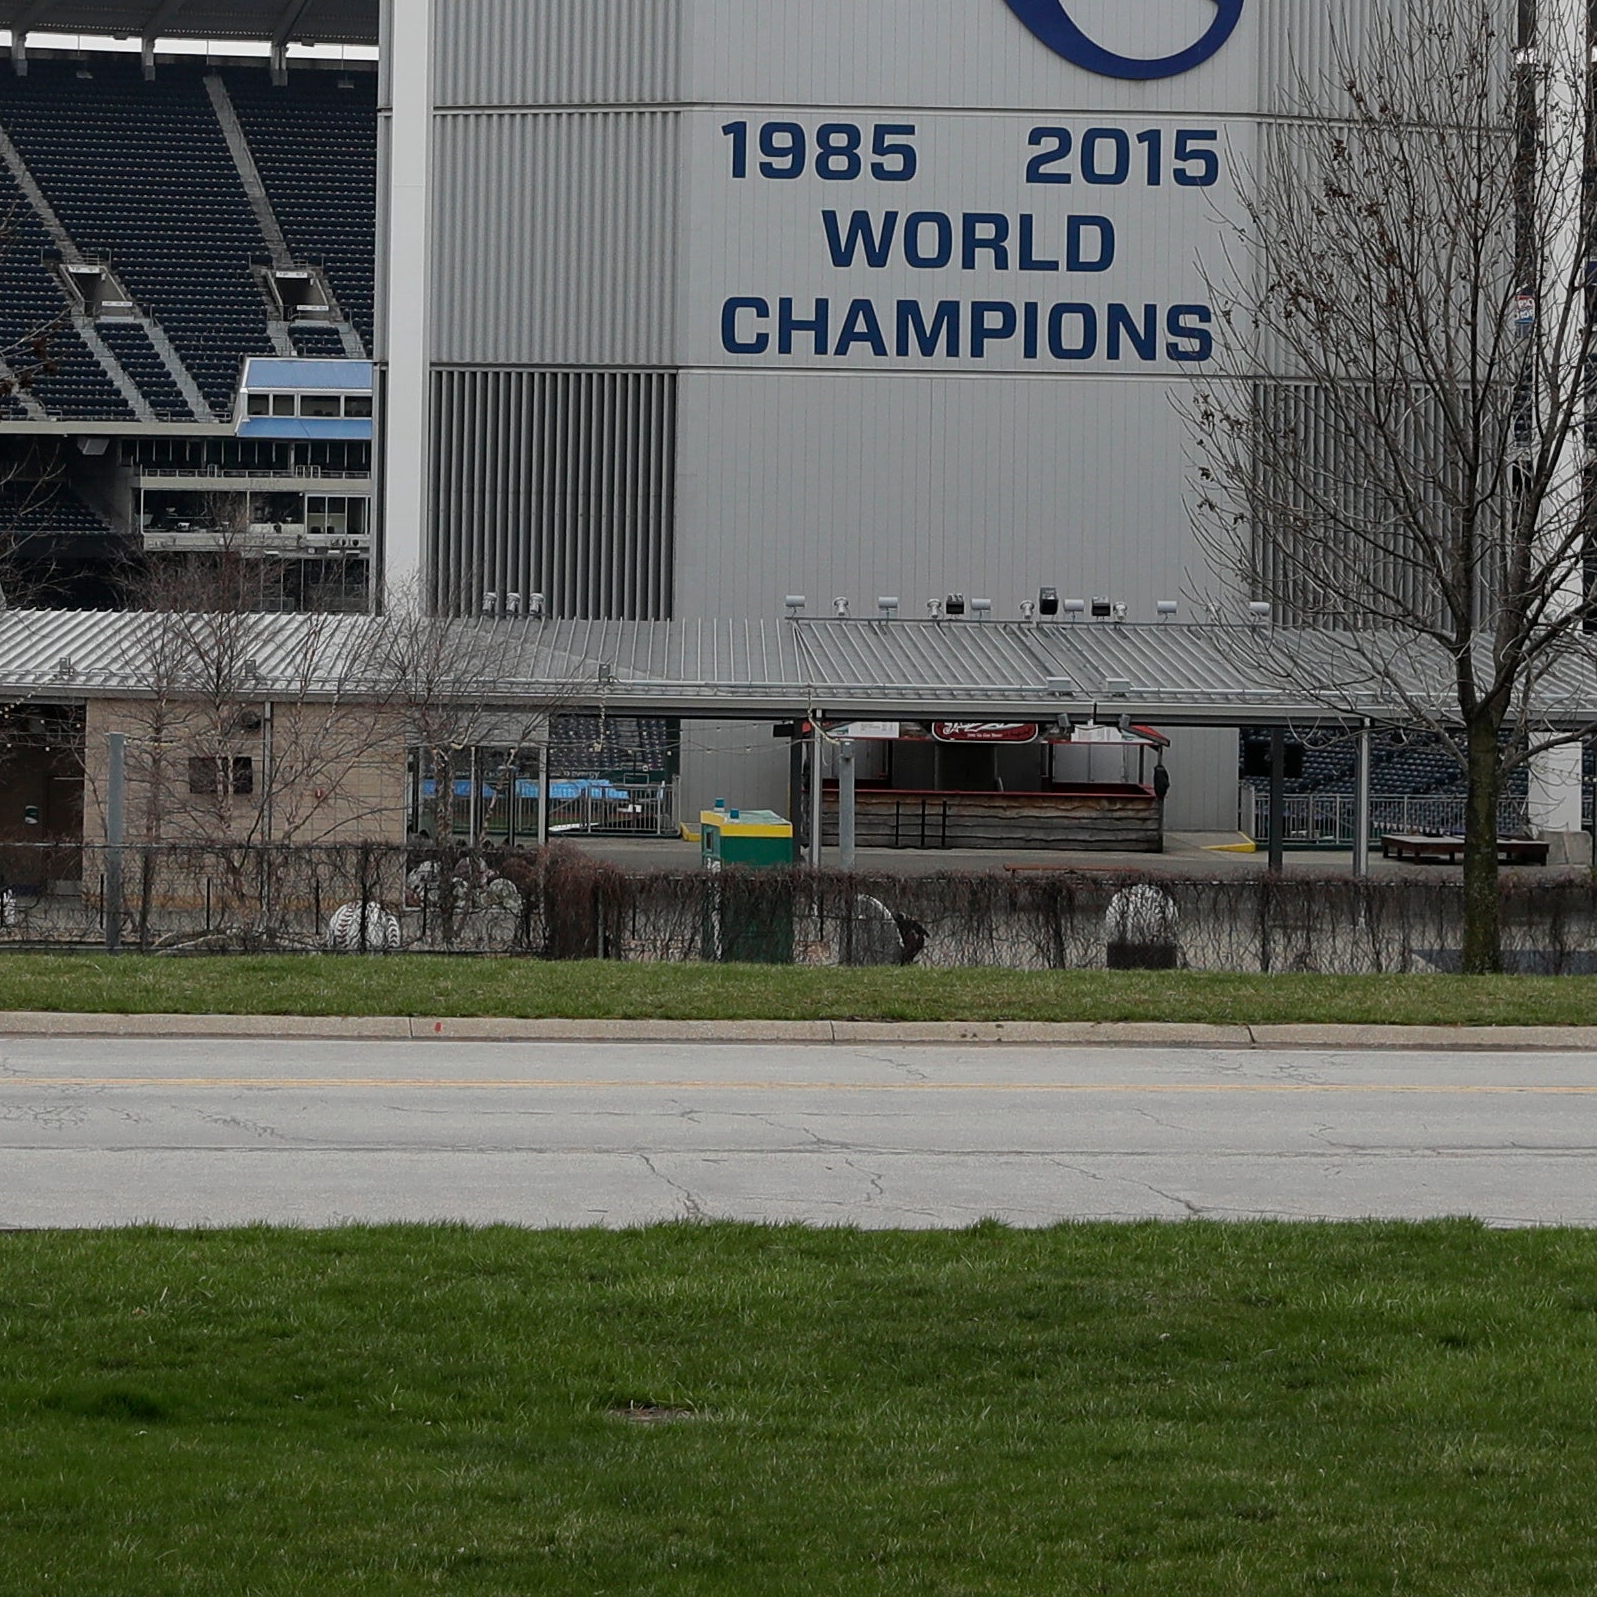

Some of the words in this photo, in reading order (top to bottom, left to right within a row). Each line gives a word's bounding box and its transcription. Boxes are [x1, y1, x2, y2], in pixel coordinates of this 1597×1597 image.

[722, 121, 917, 181] 1985
[1026, 126, 1219, 186] 2015
[823, 209, 1116, 273] WORLD
[722, 296, 1212, 361] CHAMPIONS
